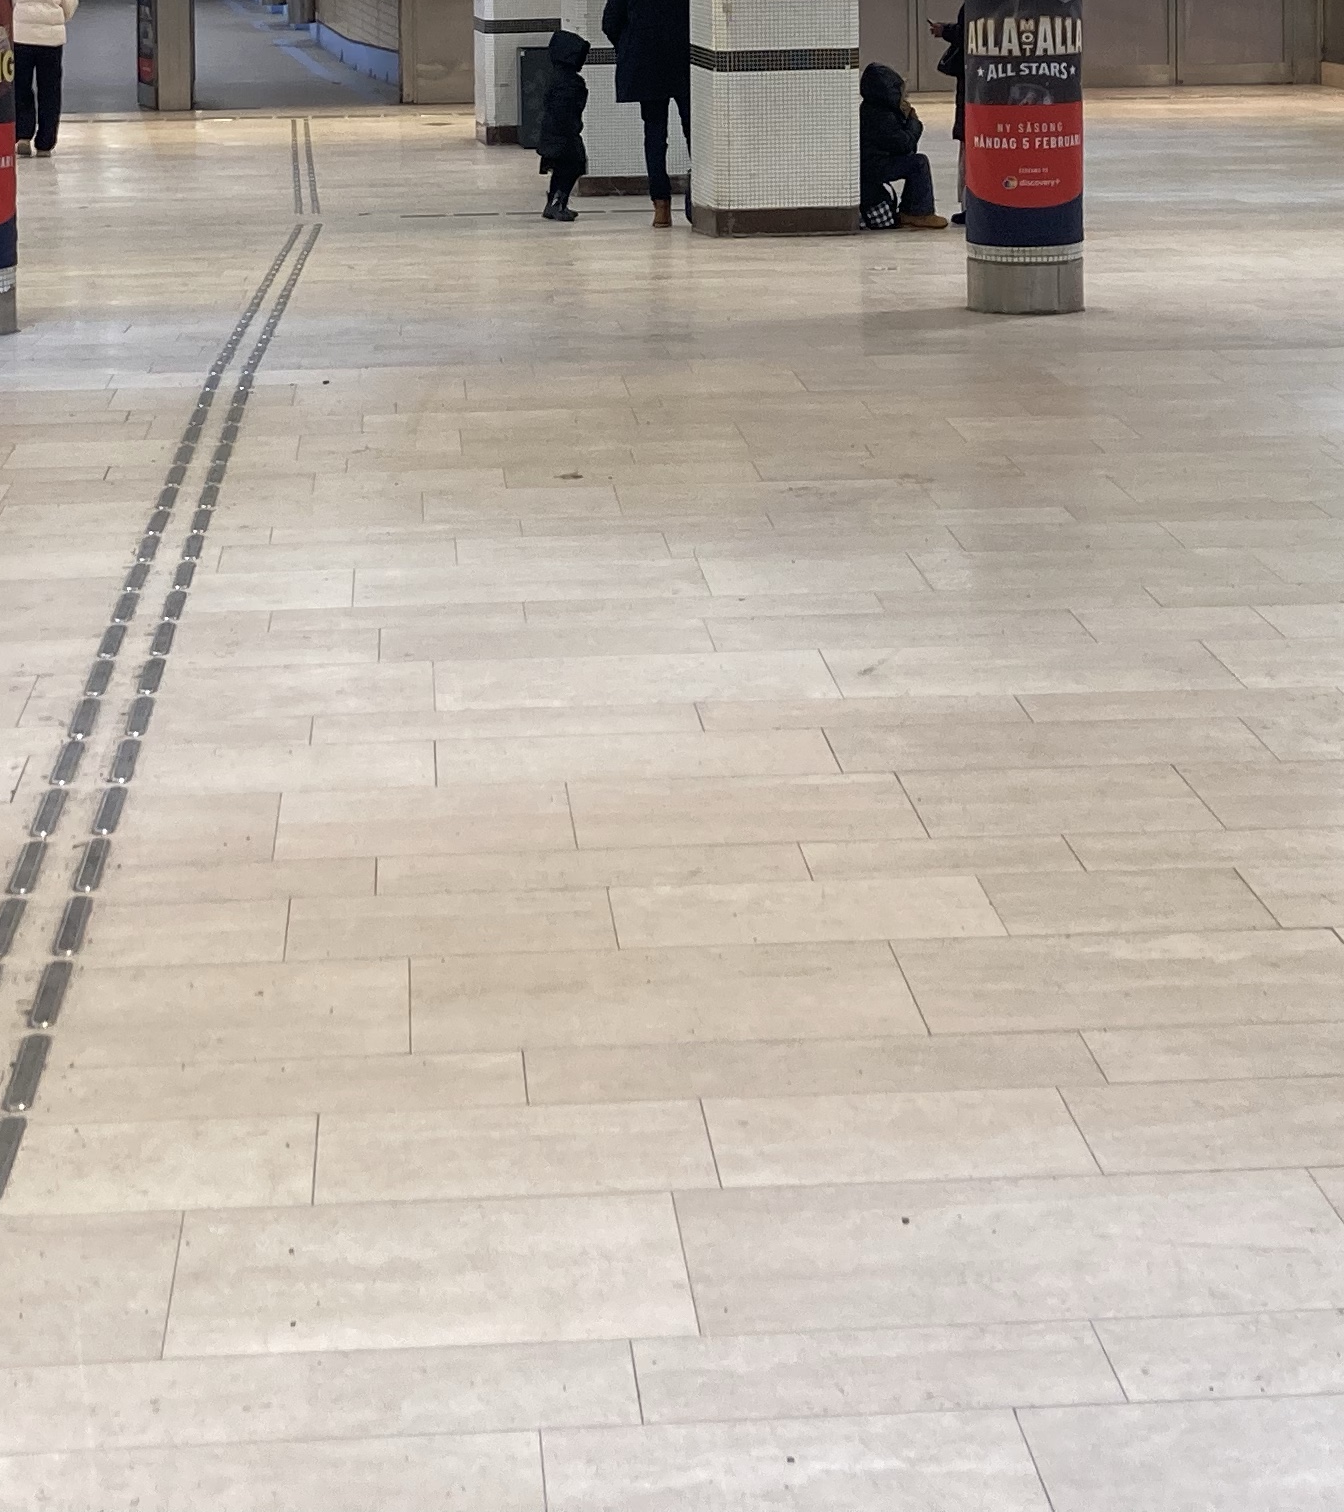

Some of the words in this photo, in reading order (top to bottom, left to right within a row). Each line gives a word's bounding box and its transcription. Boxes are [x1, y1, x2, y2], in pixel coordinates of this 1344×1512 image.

[967, 16, 1022, 57] ALLA
[1019, 18, 1035, 57] MOT
[1035, 15, 1083, 57] ALLA
[986, 62, 1016, 82] ALL
[1019, 62, 1068, 80] STARS
[997, 122, 1011, 133] NY
[973, 134, 1017, 150] MÅNDAG
[1022, 137, 1030, 150] 5
